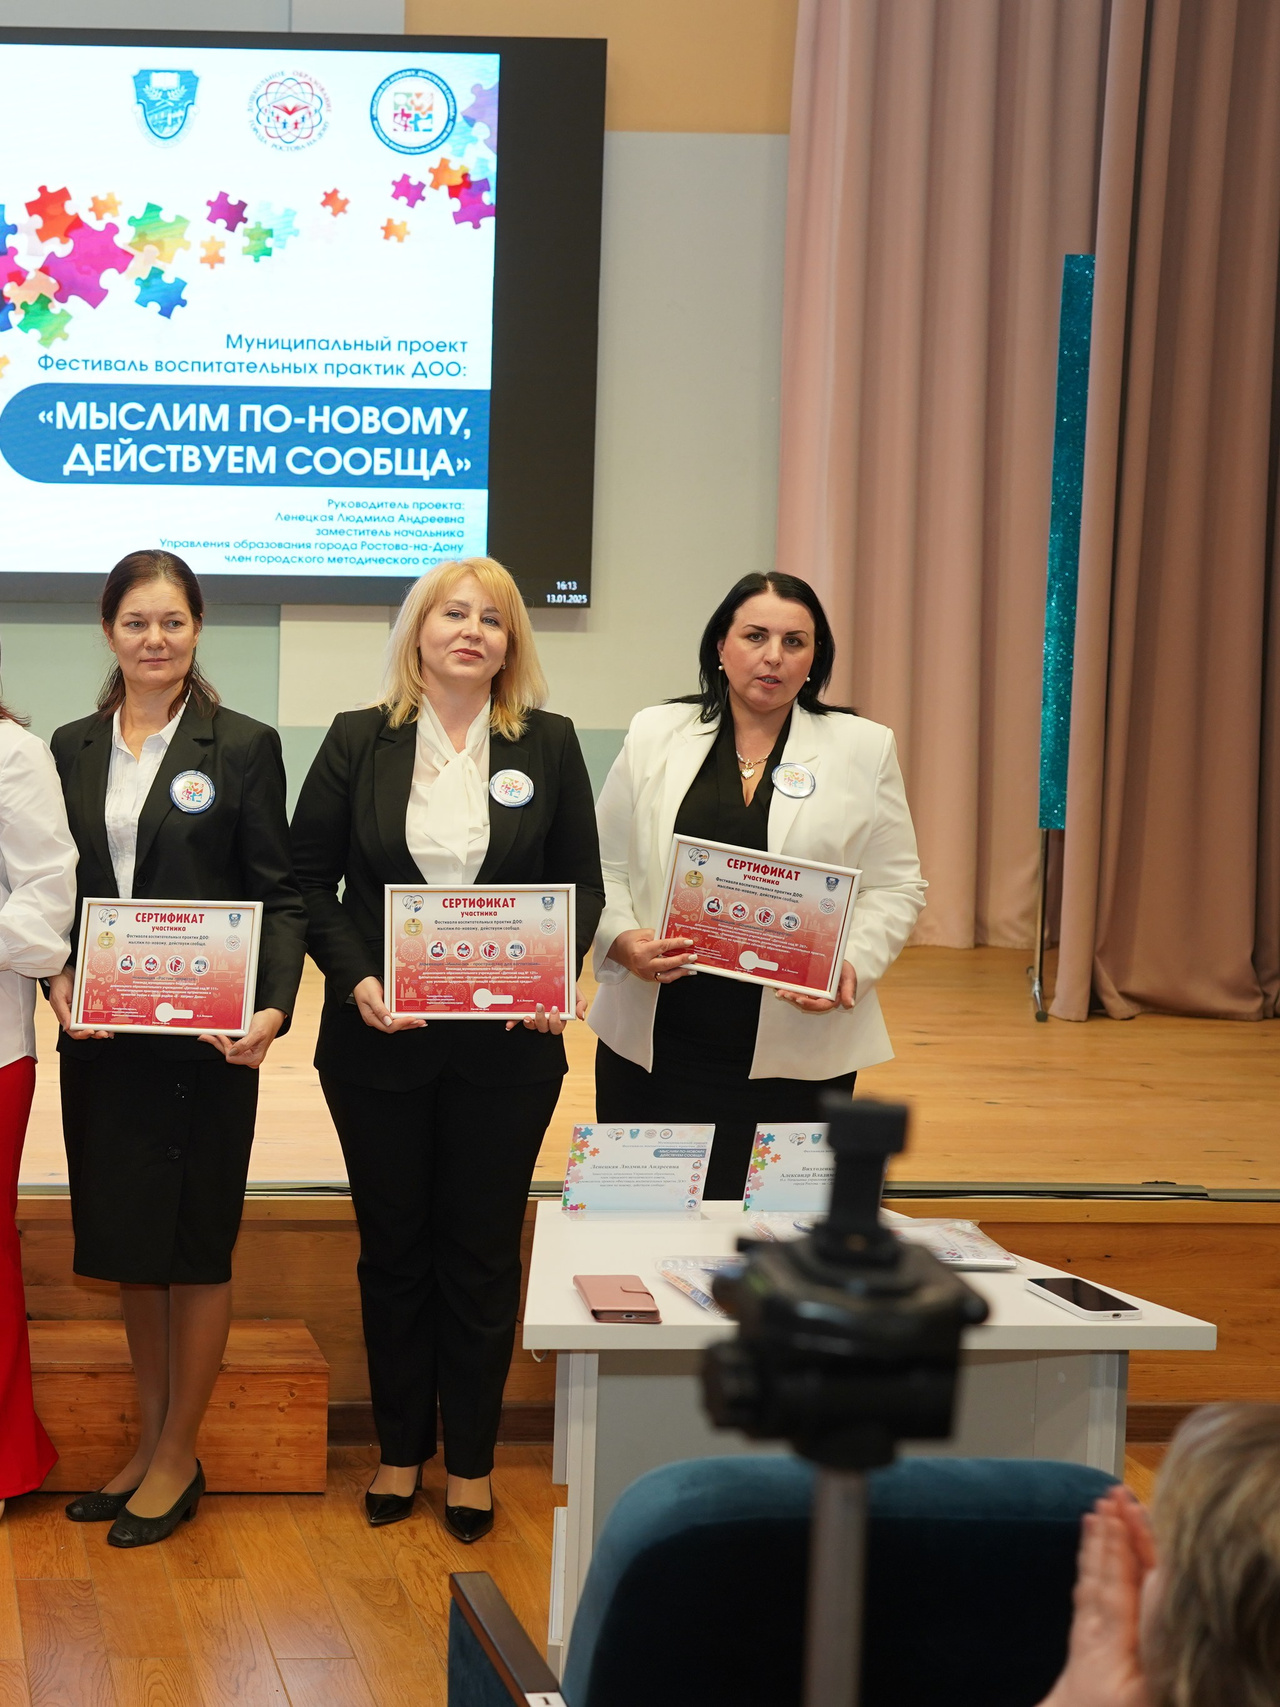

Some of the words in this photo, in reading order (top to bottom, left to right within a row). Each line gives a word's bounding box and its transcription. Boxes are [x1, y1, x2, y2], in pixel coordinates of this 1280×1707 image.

[226, 333, 391, 353] Муниципальный
[397, 339, 468, 355] проект
[37, 354, 149, 372] Фестиваль
[154, 359, 318, 375] воспитательных
[324, 362, 405, 378] практик
[411, 361, 467, 379] ДОО:
[38, 401, 230, 432] «МЫСЛИМ
[239, 404, 471, 440] ПО-НОВОМУ,
[62, 437, 277, 477] ДЕЙСТВУЕМ
[285, 446, 471, 481] СООБЩА»
[327, 499, 409, 510] Руководитель
[412, 501, 465, 511] проекта:
[275, 512, 334, 523] Ленецкая
[337, 513, 395, 524] Людмила
[397, 514, 465, 525] Андреевна
[315, 528, 391, 537] заместитель
[393, 529, 465, 538] начальника
[159, 538, 230, 549] Управления
[233, 539, 312, 550] образования
[314, 541, 358, 551] города
[360, 541, 464, 553] Ростова-на-Дону
[224, 555, 252, 563] член
[254, 555, 324, 565] городского
[327, 556, 420, 566] методического
[556, 581, 578, 590] 16:13
[546, 594, 588, 603] 13.01.2025
[726, 857, 801, 882] СЕРТИФИКАТ
[743, 873, 780, 886] участника
[442, 897, 517, 909] СЕРТИФИКАТ
[135, 912, 205, 924] СЕРТИФИКАТ
